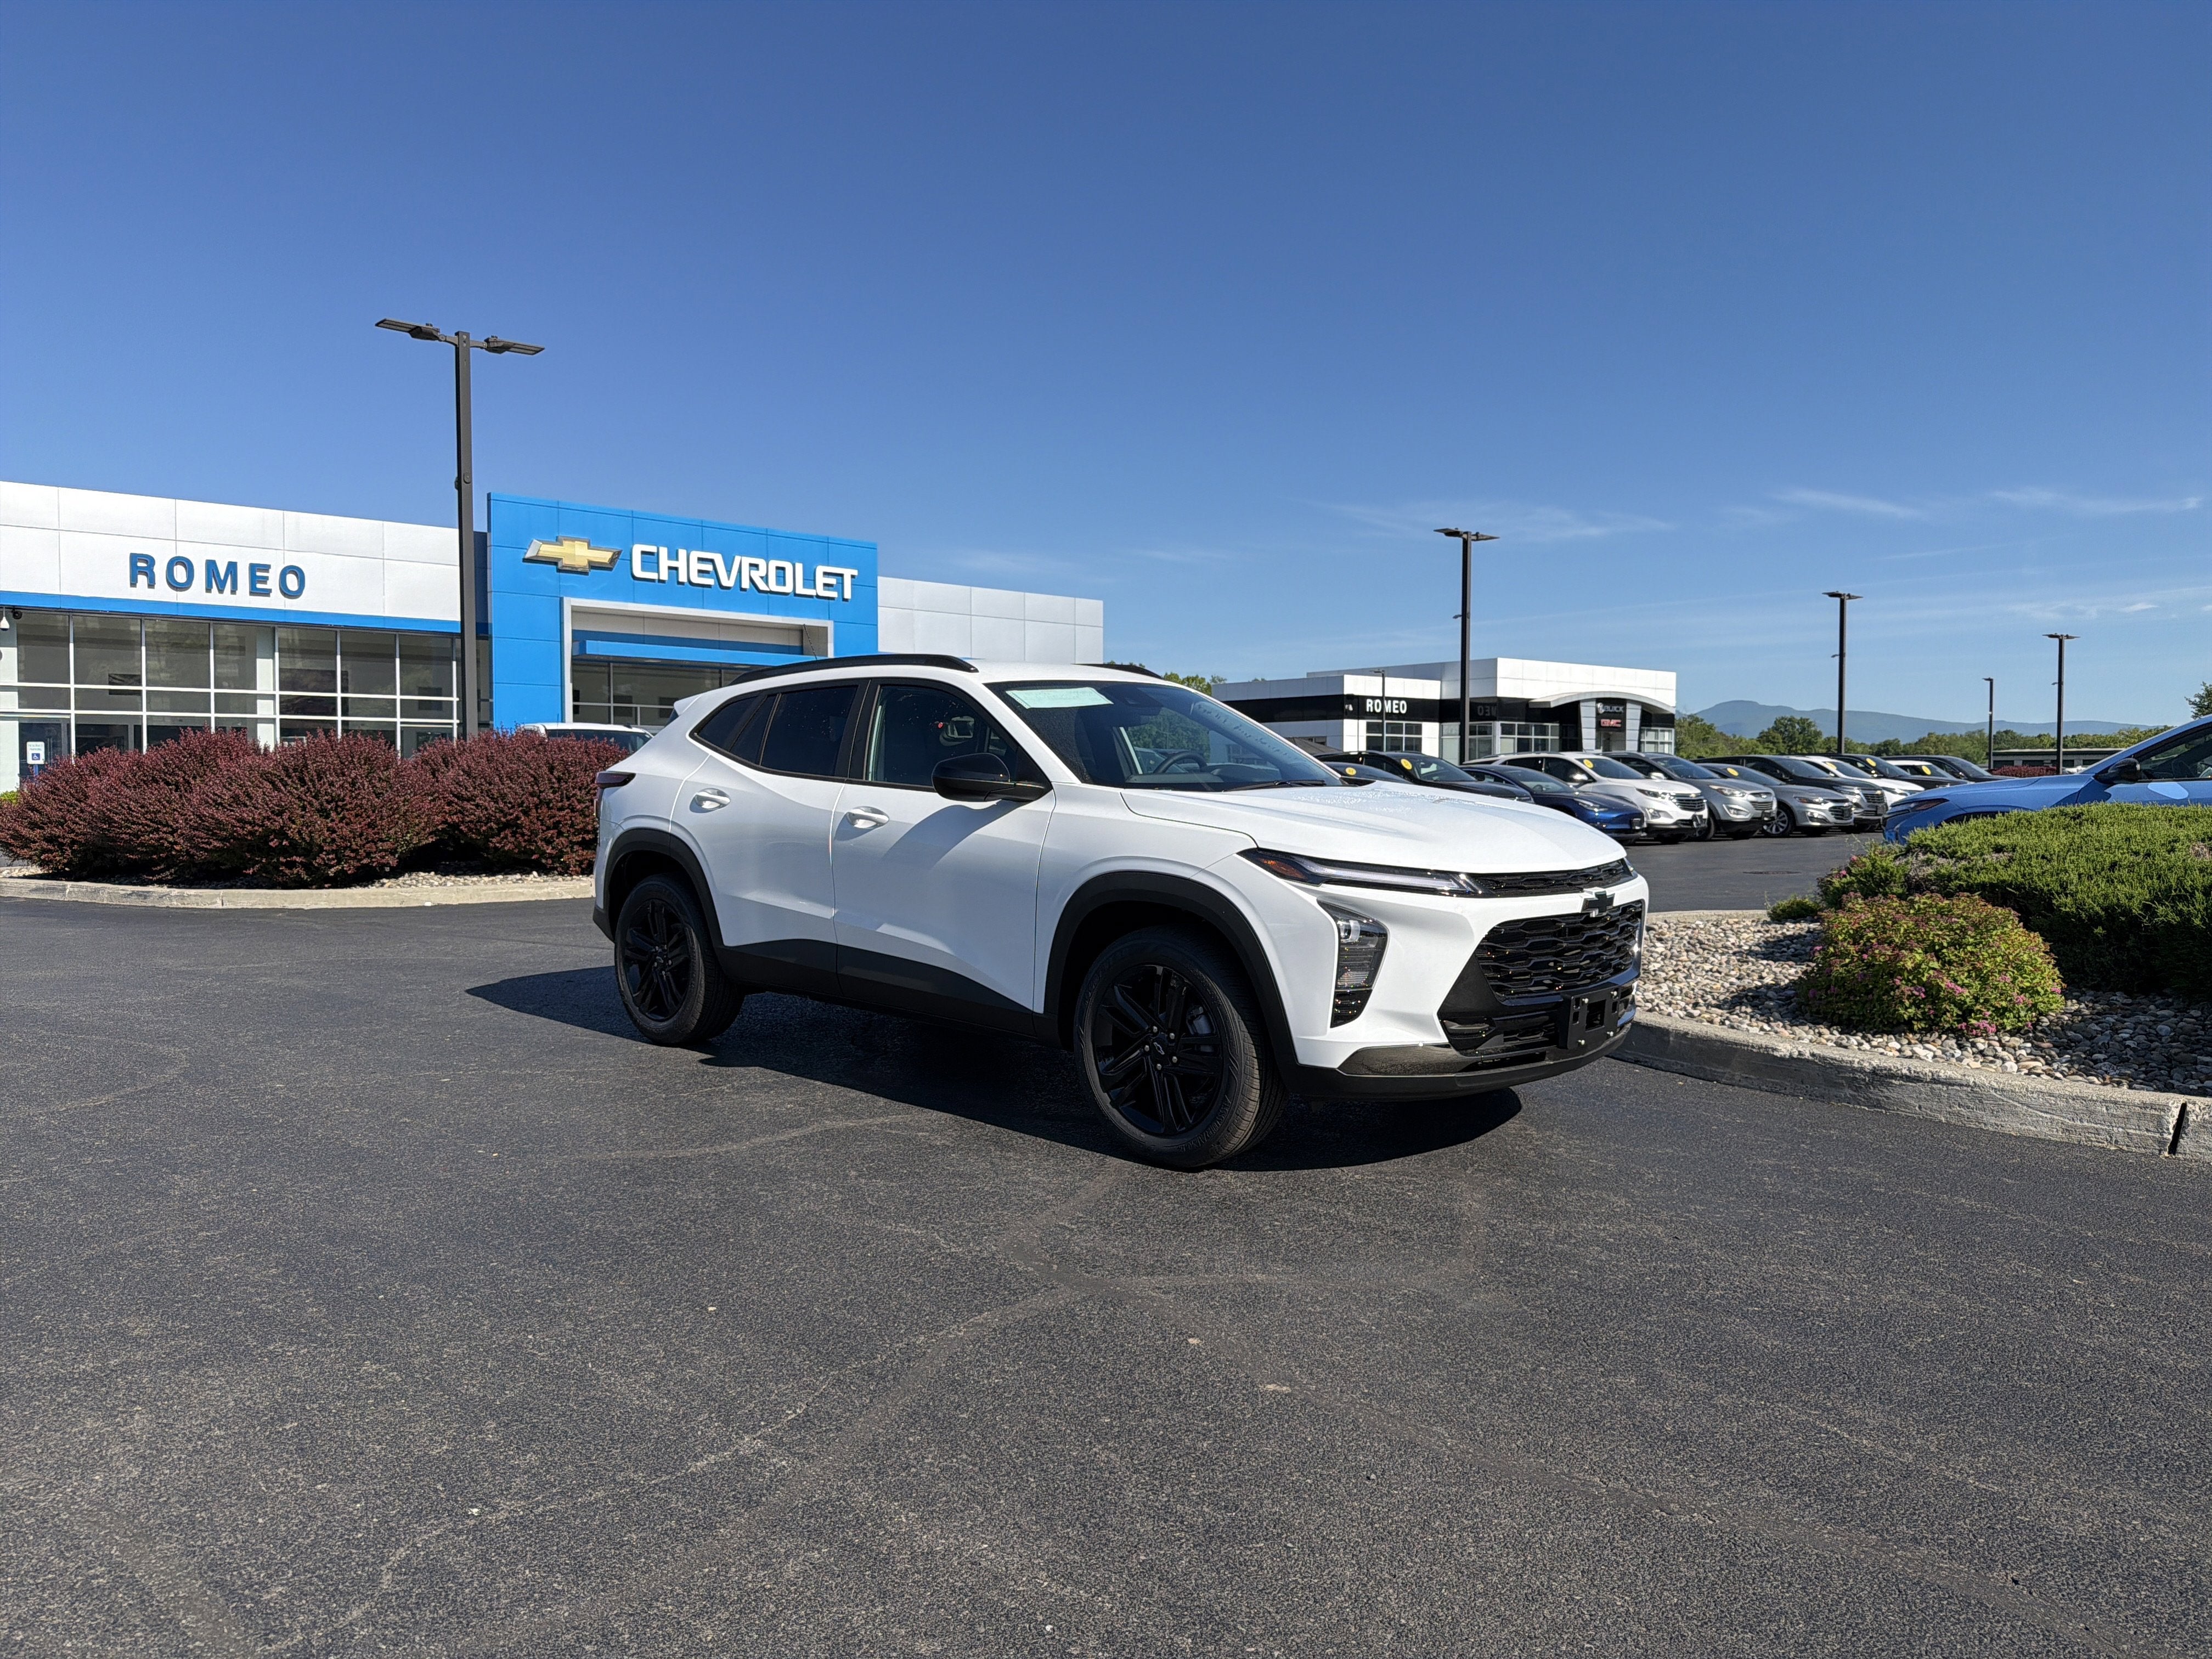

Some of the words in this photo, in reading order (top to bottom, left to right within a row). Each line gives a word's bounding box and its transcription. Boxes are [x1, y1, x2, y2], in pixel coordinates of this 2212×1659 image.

[129, 552, 305, 599] ROMEO
[631, 544, 859, 600] CHEVROLET
[1367, 698, 1407, 714] ROMEO
[1600, 719, 1621, 727] GMC
